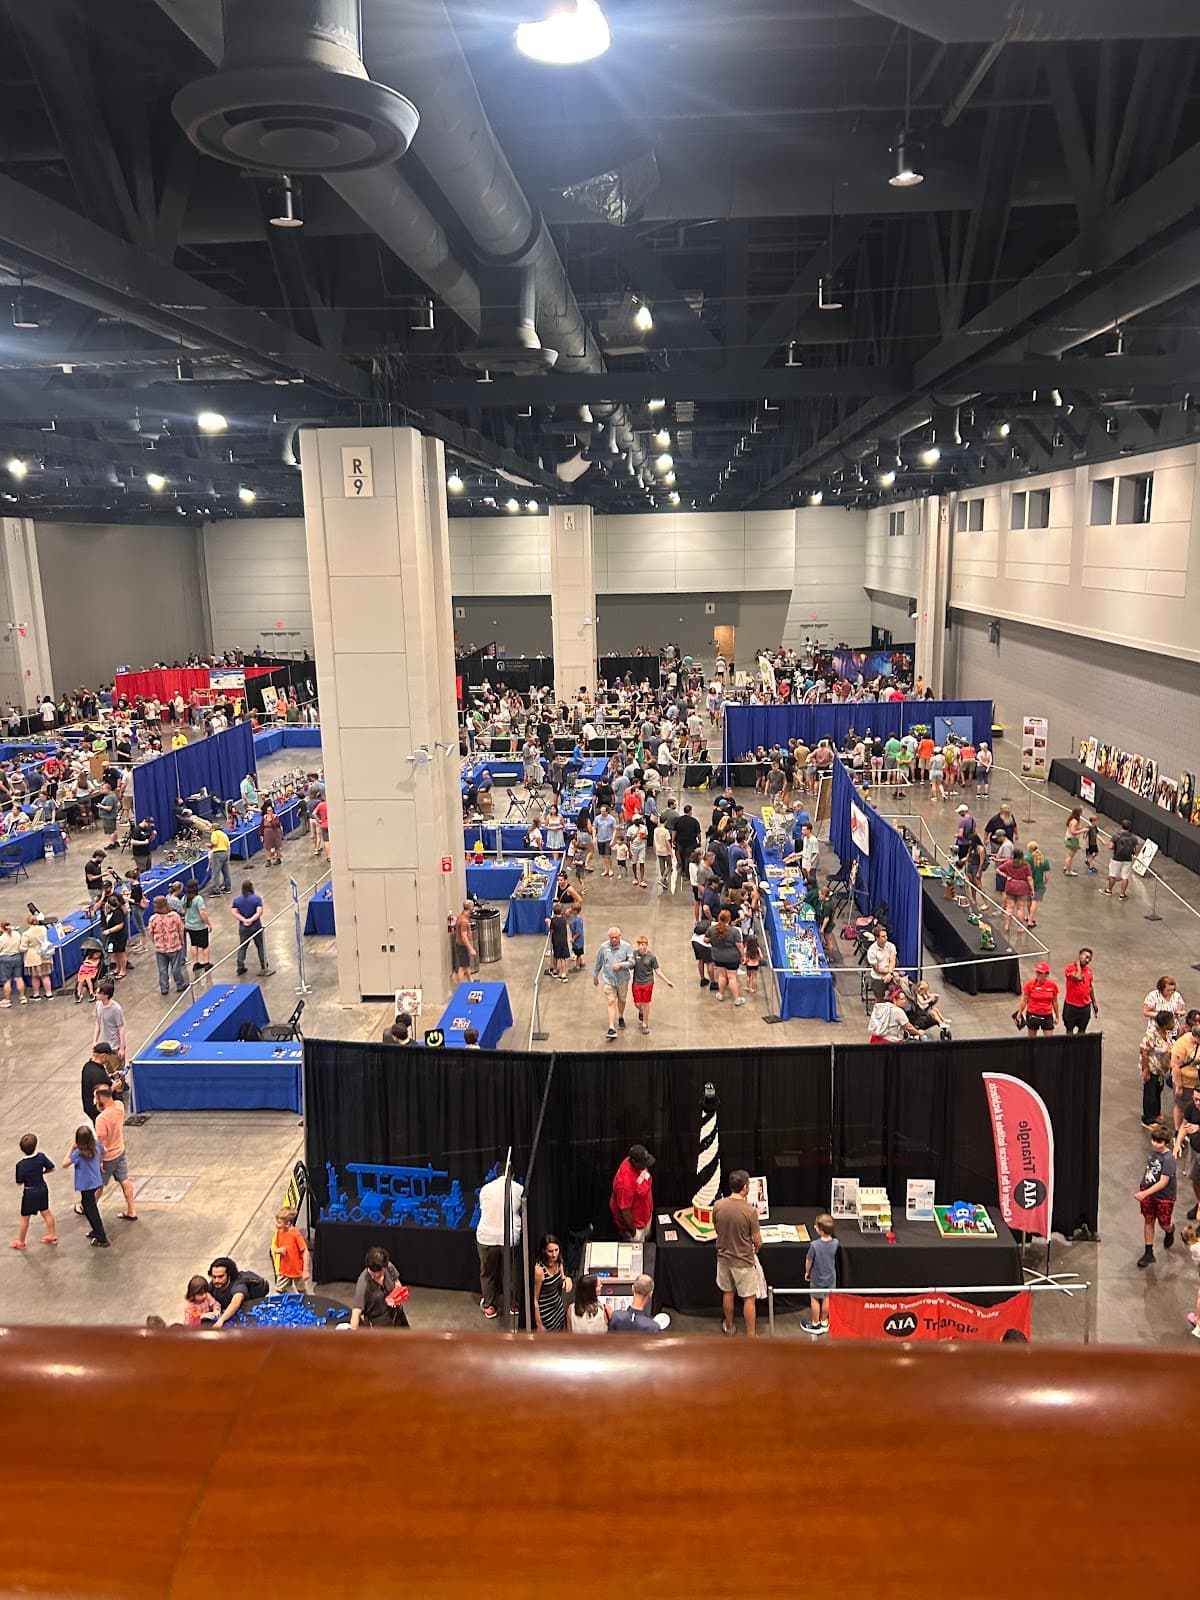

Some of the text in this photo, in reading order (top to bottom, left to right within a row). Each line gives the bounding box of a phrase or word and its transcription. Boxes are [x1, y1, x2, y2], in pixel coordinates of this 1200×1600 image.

[352, 458, 363, 474] R
[353, 478, 363, 495] 9
[885, 1316, 979, 1334] AIA Triangle
